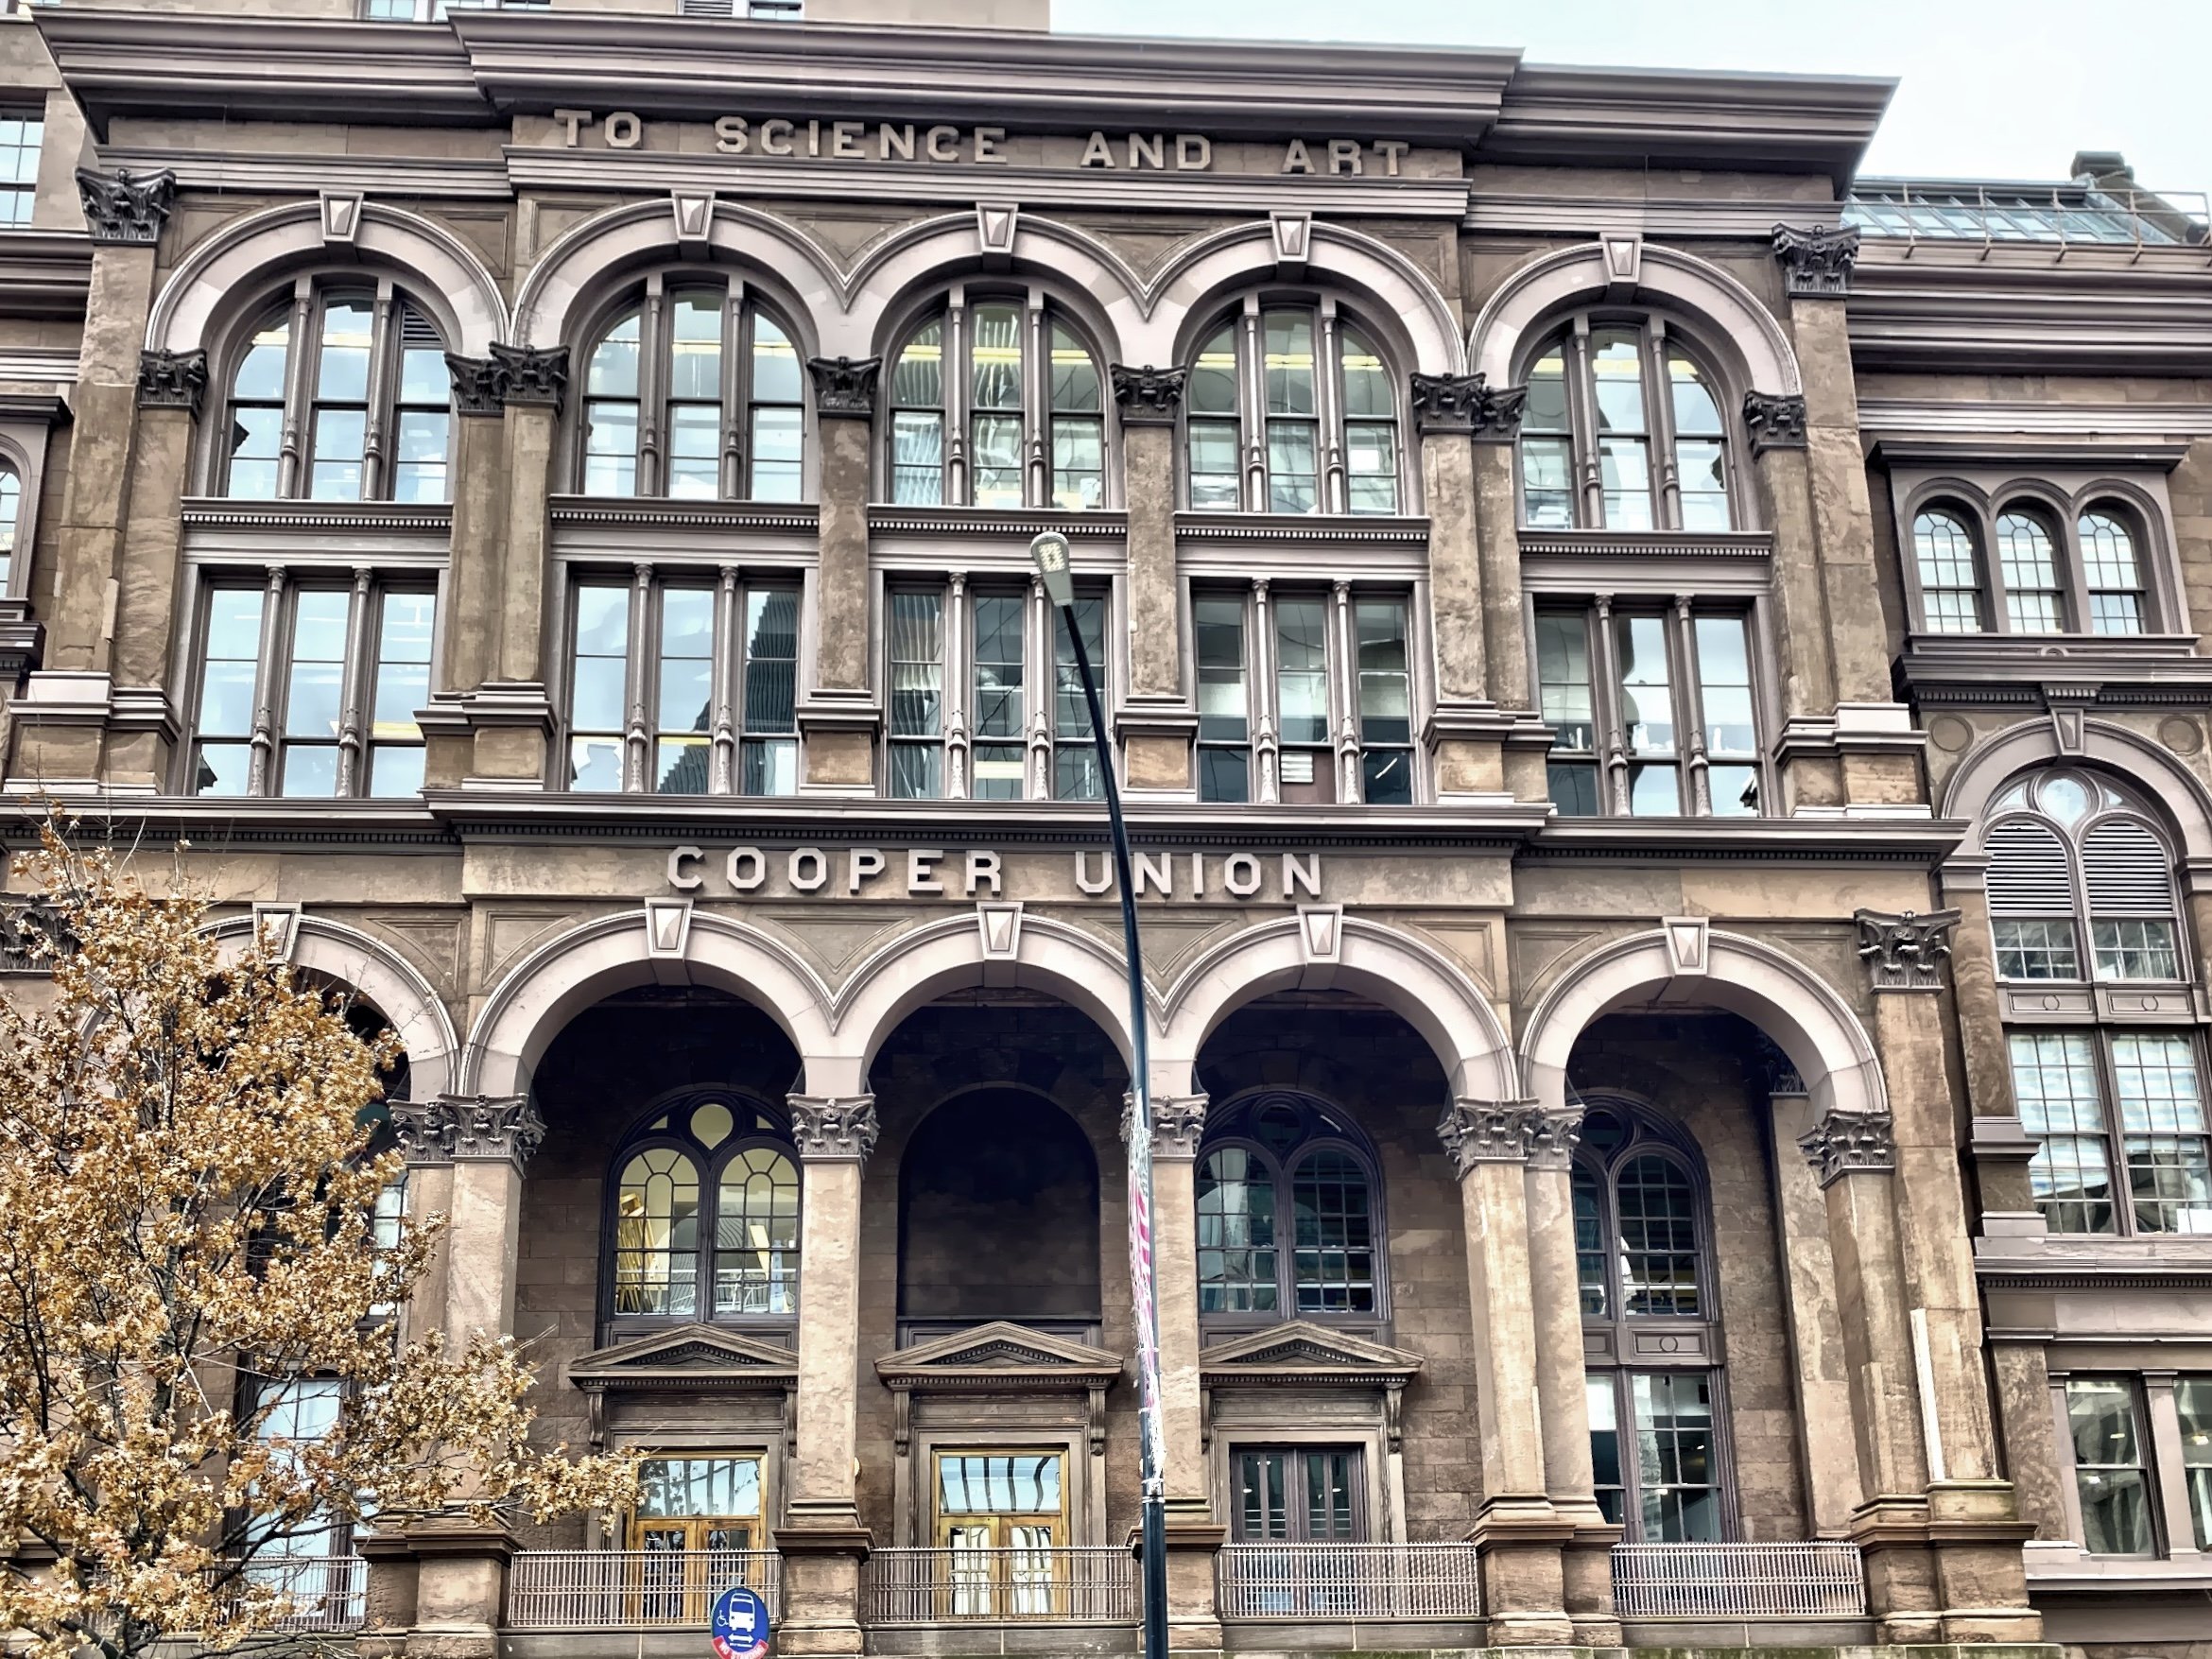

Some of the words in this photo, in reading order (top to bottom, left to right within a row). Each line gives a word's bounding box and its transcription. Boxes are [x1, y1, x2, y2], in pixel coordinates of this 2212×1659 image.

[554, 110, 642, 149] TO
[715, 116, 1007, 164] SCIENCE
[1080, 130, 1211, 170] AND
[1282, 138, 1409, 177] ART
[667, 846, 1002, 894] COOPER
[1076, 851, 1322, 897] UNION
